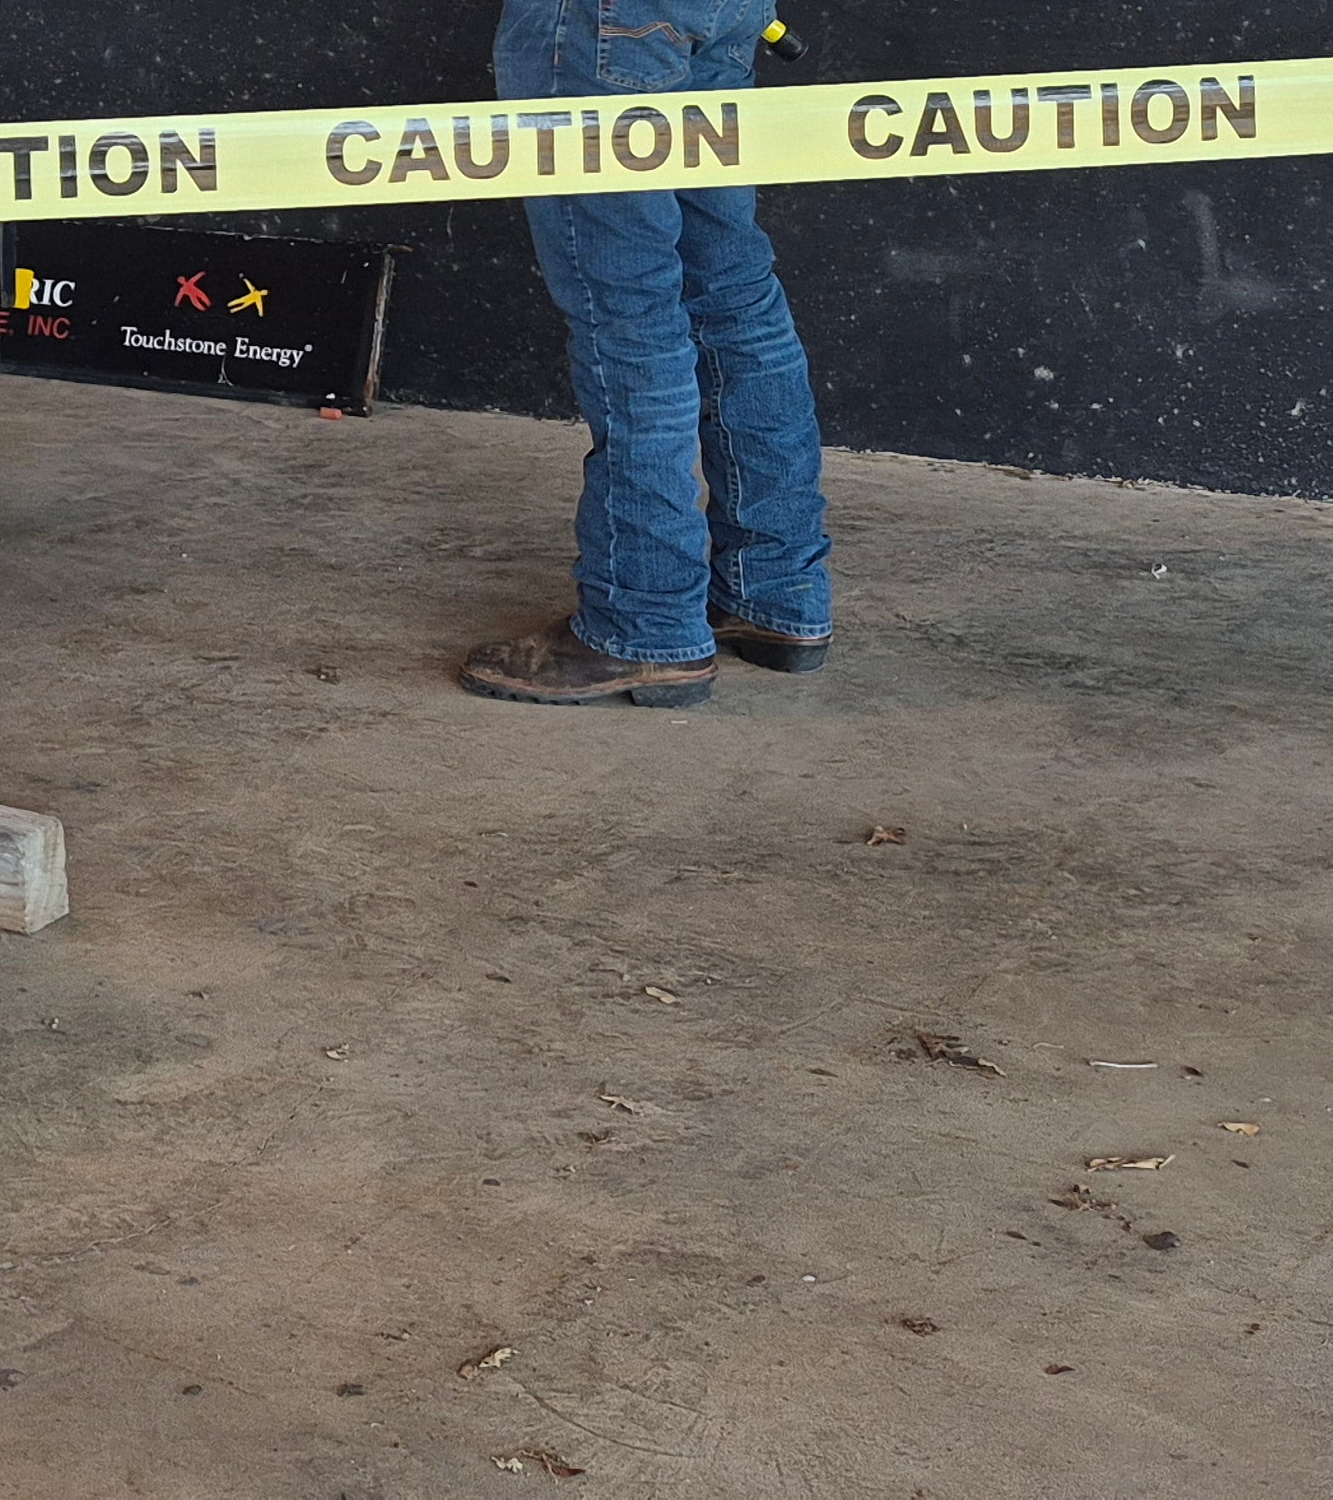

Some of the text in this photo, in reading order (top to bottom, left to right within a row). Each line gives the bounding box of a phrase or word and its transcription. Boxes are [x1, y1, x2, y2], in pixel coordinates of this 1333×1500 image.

[325, 102, 740, 186] CAUTION
[848, 74, 1257, 160] CAUTION
[29, 278, 76, 308] RIC
[120, 325, 227, 356] Touchstone
